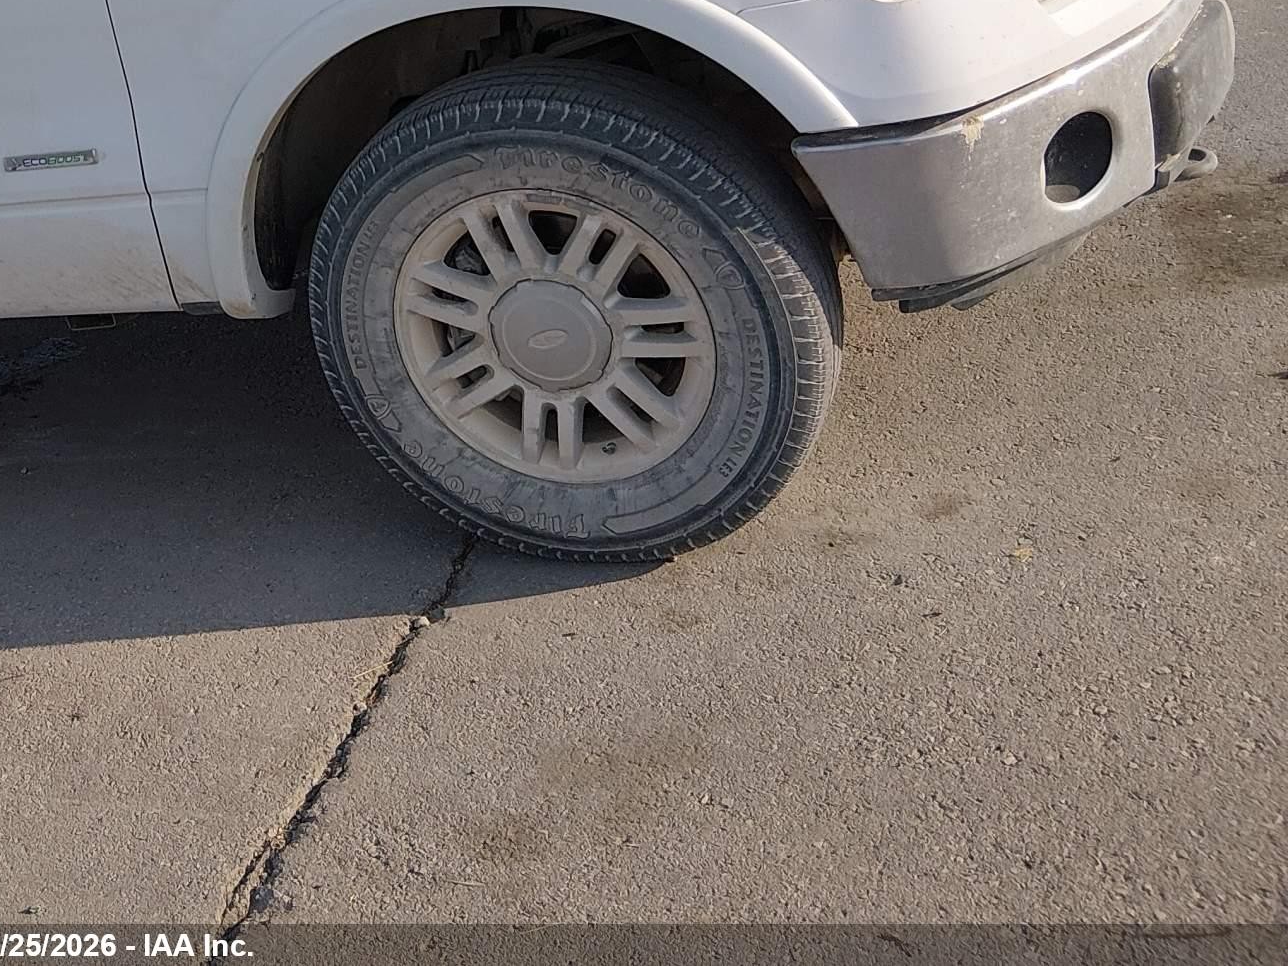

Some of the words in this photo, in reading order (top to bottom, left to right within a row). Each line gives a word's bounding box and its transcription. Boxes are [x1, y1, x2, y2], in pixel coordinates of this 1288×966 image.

[494, 145, 701, 238] Firestone
[344, 242, 371, 370] DESTINATION
[728, 317, 765, 458] DESTINATION
